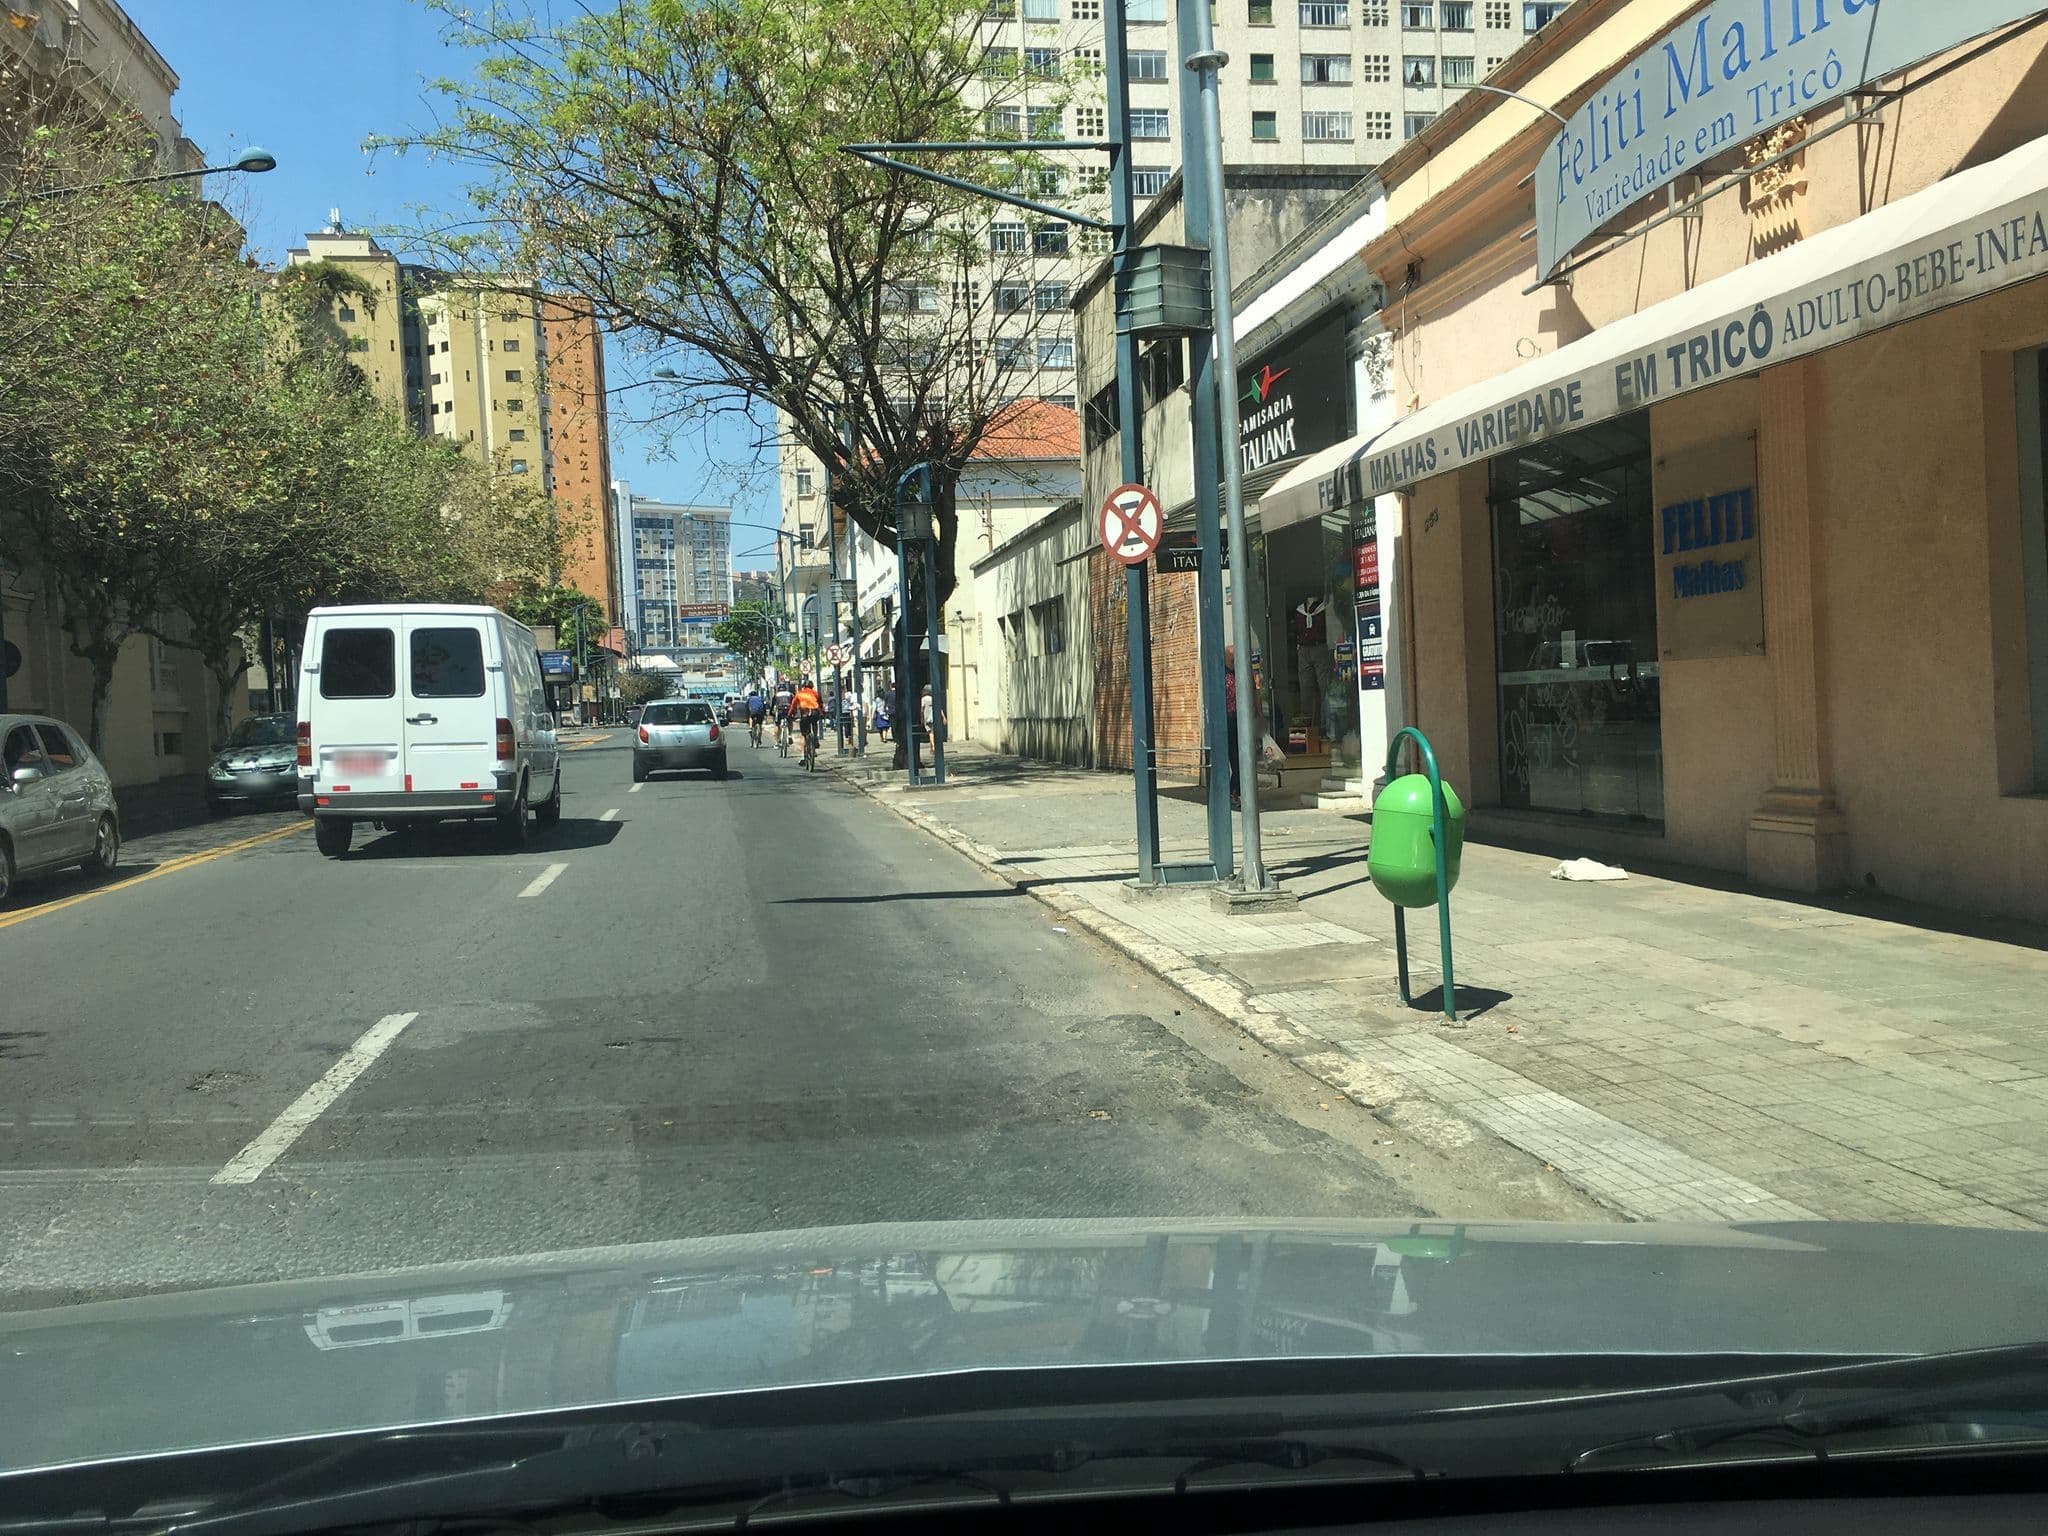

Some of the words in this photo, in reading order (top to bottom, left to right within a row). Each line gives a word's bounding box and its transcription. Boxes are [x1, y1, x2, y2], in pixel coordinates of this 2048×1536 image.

[1557, 69, 1646, 204] Feliti
[1663, 0, 1878, 119] Mal
[1585, 135, 1686, 224] Variedade
[1695, 111, 1736, 154] em
[1747, 48, 1843, 125] Tricô
[1239, 418, 1296, 475] TALIANA
[1369, 437, 1437, 491] MALHAS
[1456, 380, 1584, 459] VARIEDADE
[1615, 353, 1658, 406] EM
[1667, 301, 1774, 389] TRICÔ
